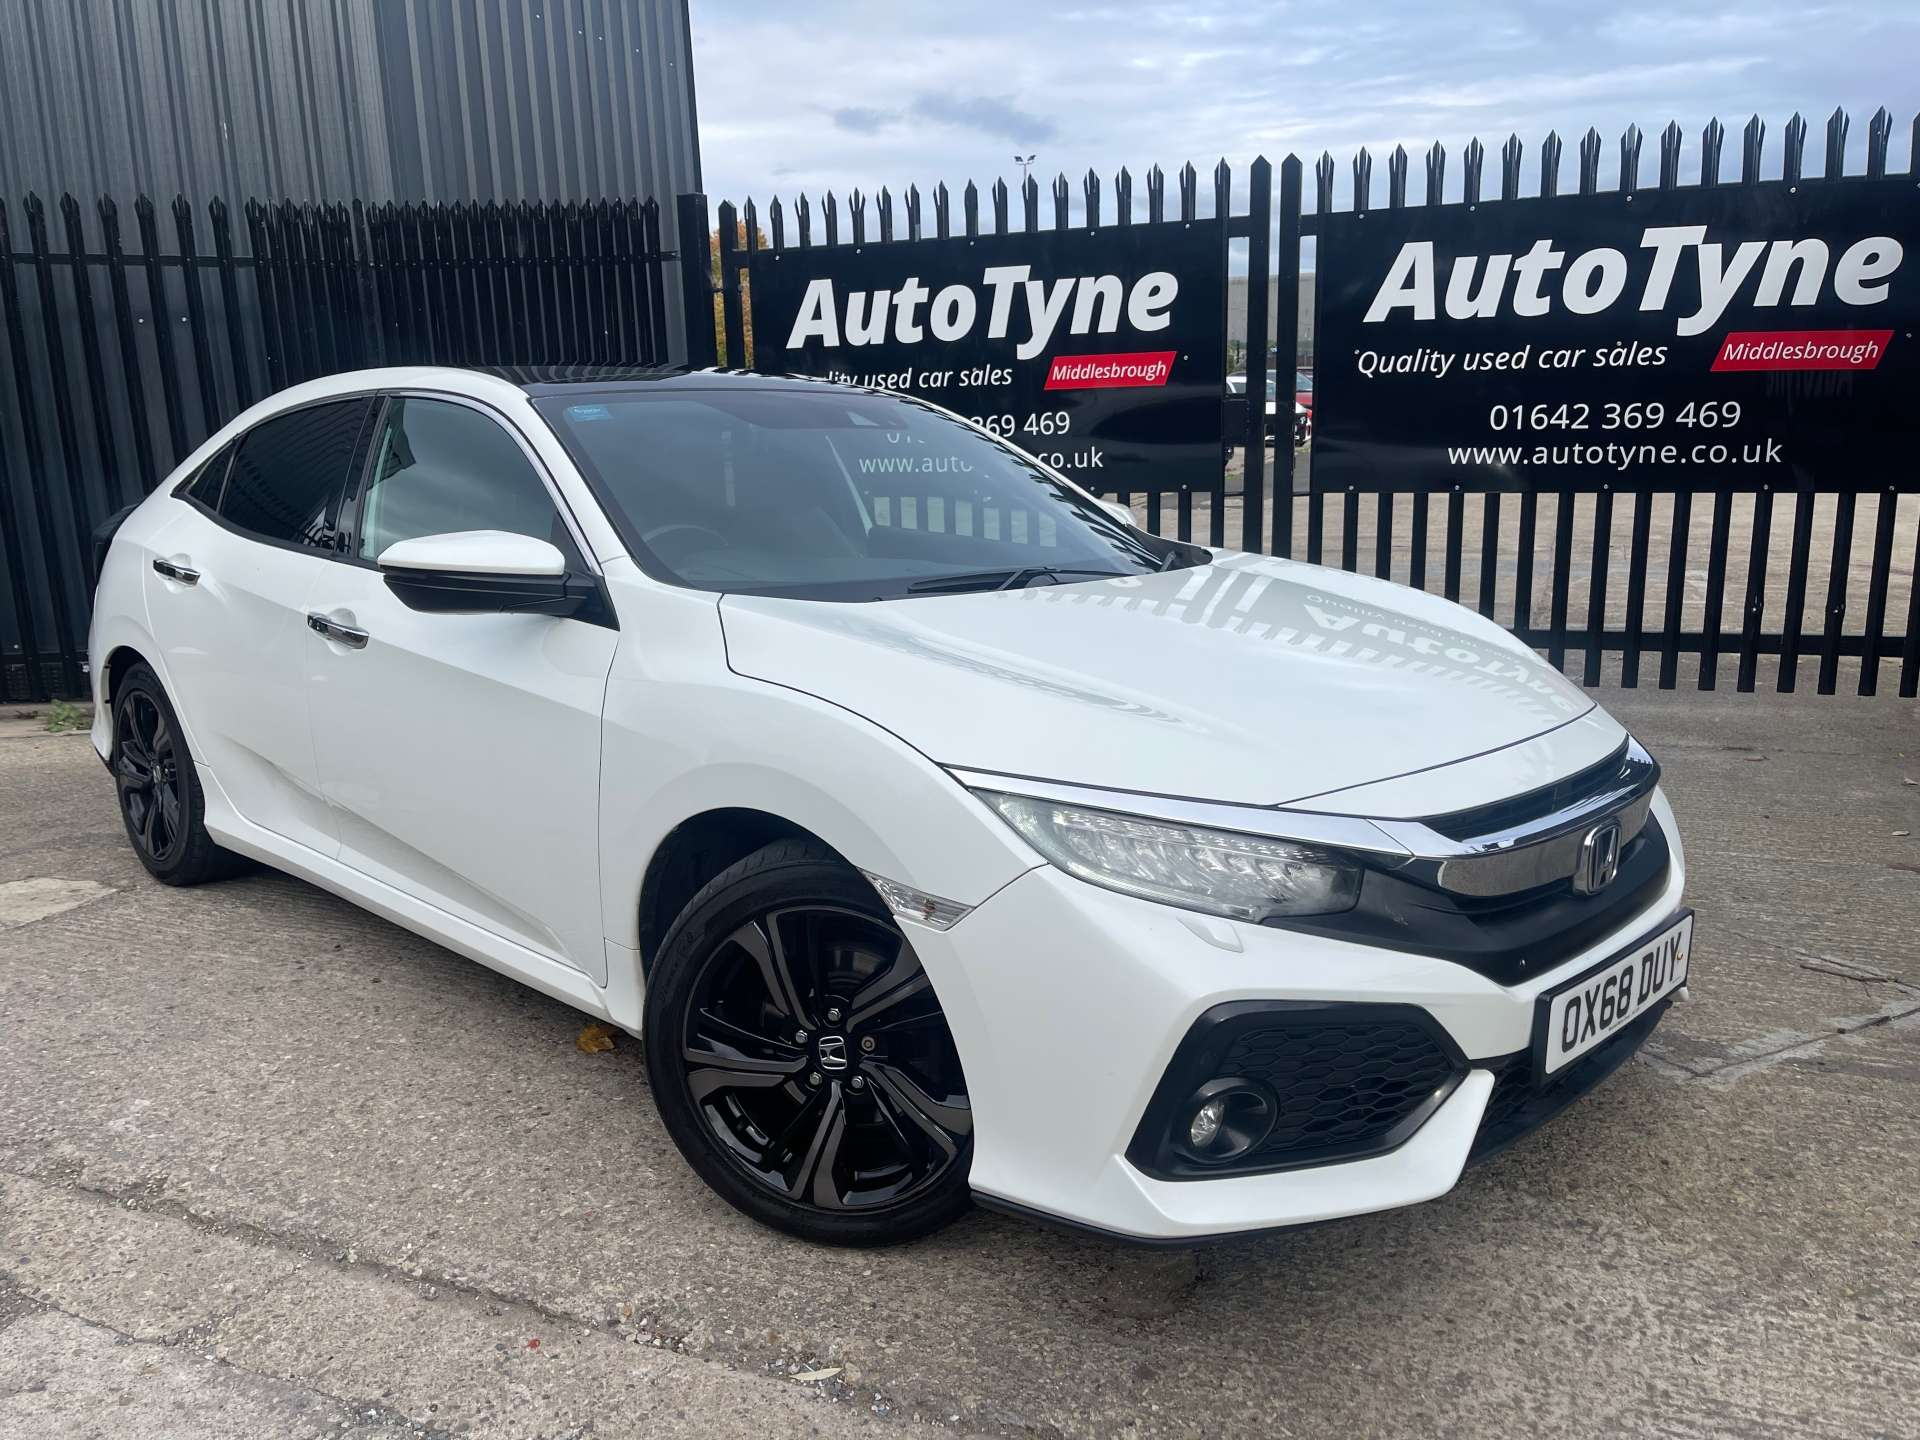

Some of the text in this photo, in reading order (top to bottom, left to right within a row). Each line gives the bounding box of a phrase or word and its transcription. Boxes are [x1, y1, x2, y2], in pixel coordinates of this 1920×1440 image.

[1363, 225, 1904, 337] AutoTyne
[786, 265, 1178, 361] AutoTyne
[1357, 341, 1667, 379] Quality used car sales
[1724, 341, 1879, 365] Middlesbrough
[864, 367, 912, 389] used
[918, 371, 953, 388] car
[959, 364, 1013, 387] sales
[1052, 361, 1167, 383] Middlesbrough
[1023, 411, 1071, 436] 469
[1489, 401, 1741, 431] 01642 369 469
[1448, 438, 1783, 470] www.autotyne.co.uk
[1561, 931, 1682, 1053] OX68 DUY
